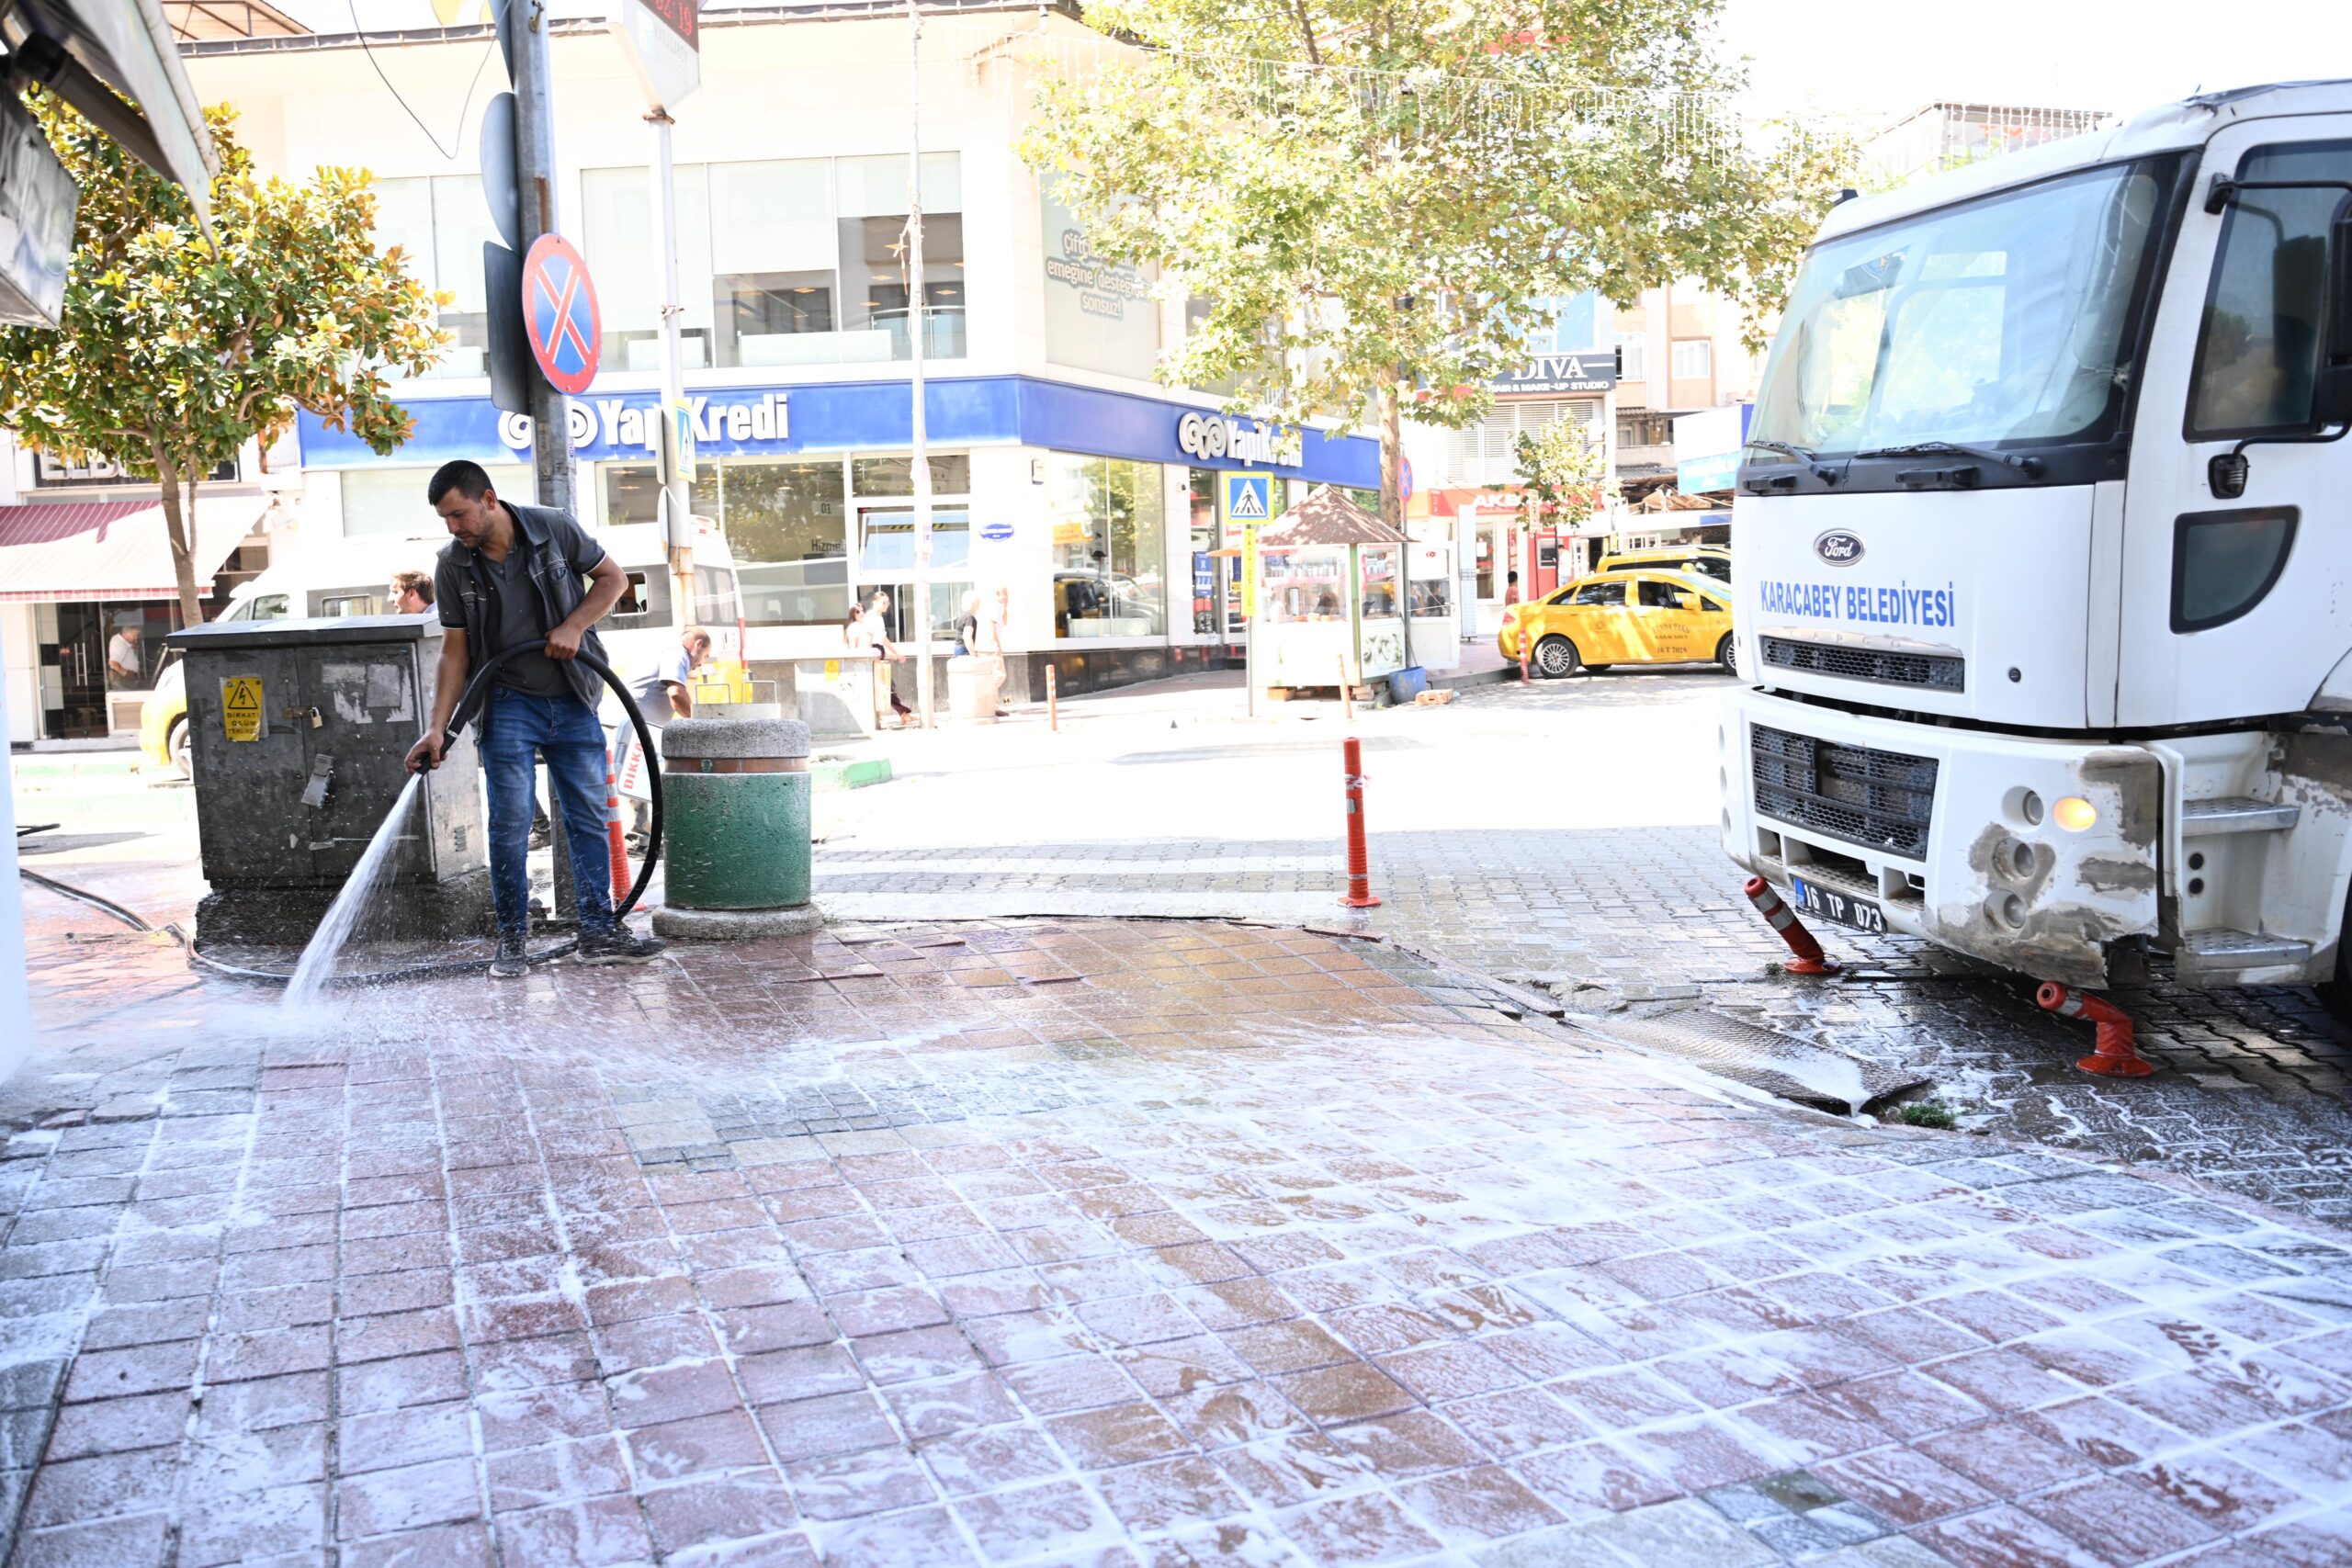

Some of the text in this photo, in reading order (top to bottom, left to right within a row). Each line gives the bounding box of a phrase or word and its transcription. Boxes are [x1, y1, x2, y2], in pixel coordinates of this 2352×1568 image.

[1047, 260, 1093, 285] emeğine
[1082, 294, 1122, 316] sonsuz!
[1521, 381, 1569, 392] MAKE-UP
[1570, 380, 1610, 390] STUDIO
[1825, 536, 1853, 558] Ford
[1760, 580, 1955, 627] KARACABEY BELEDİYESİ
[623, 740, 644, 790] DİKKA
[1804, 884, 1820, 910] 16
[1826, 893, 1845, 919] TP
[1853, 902, 1883, 931] 073
